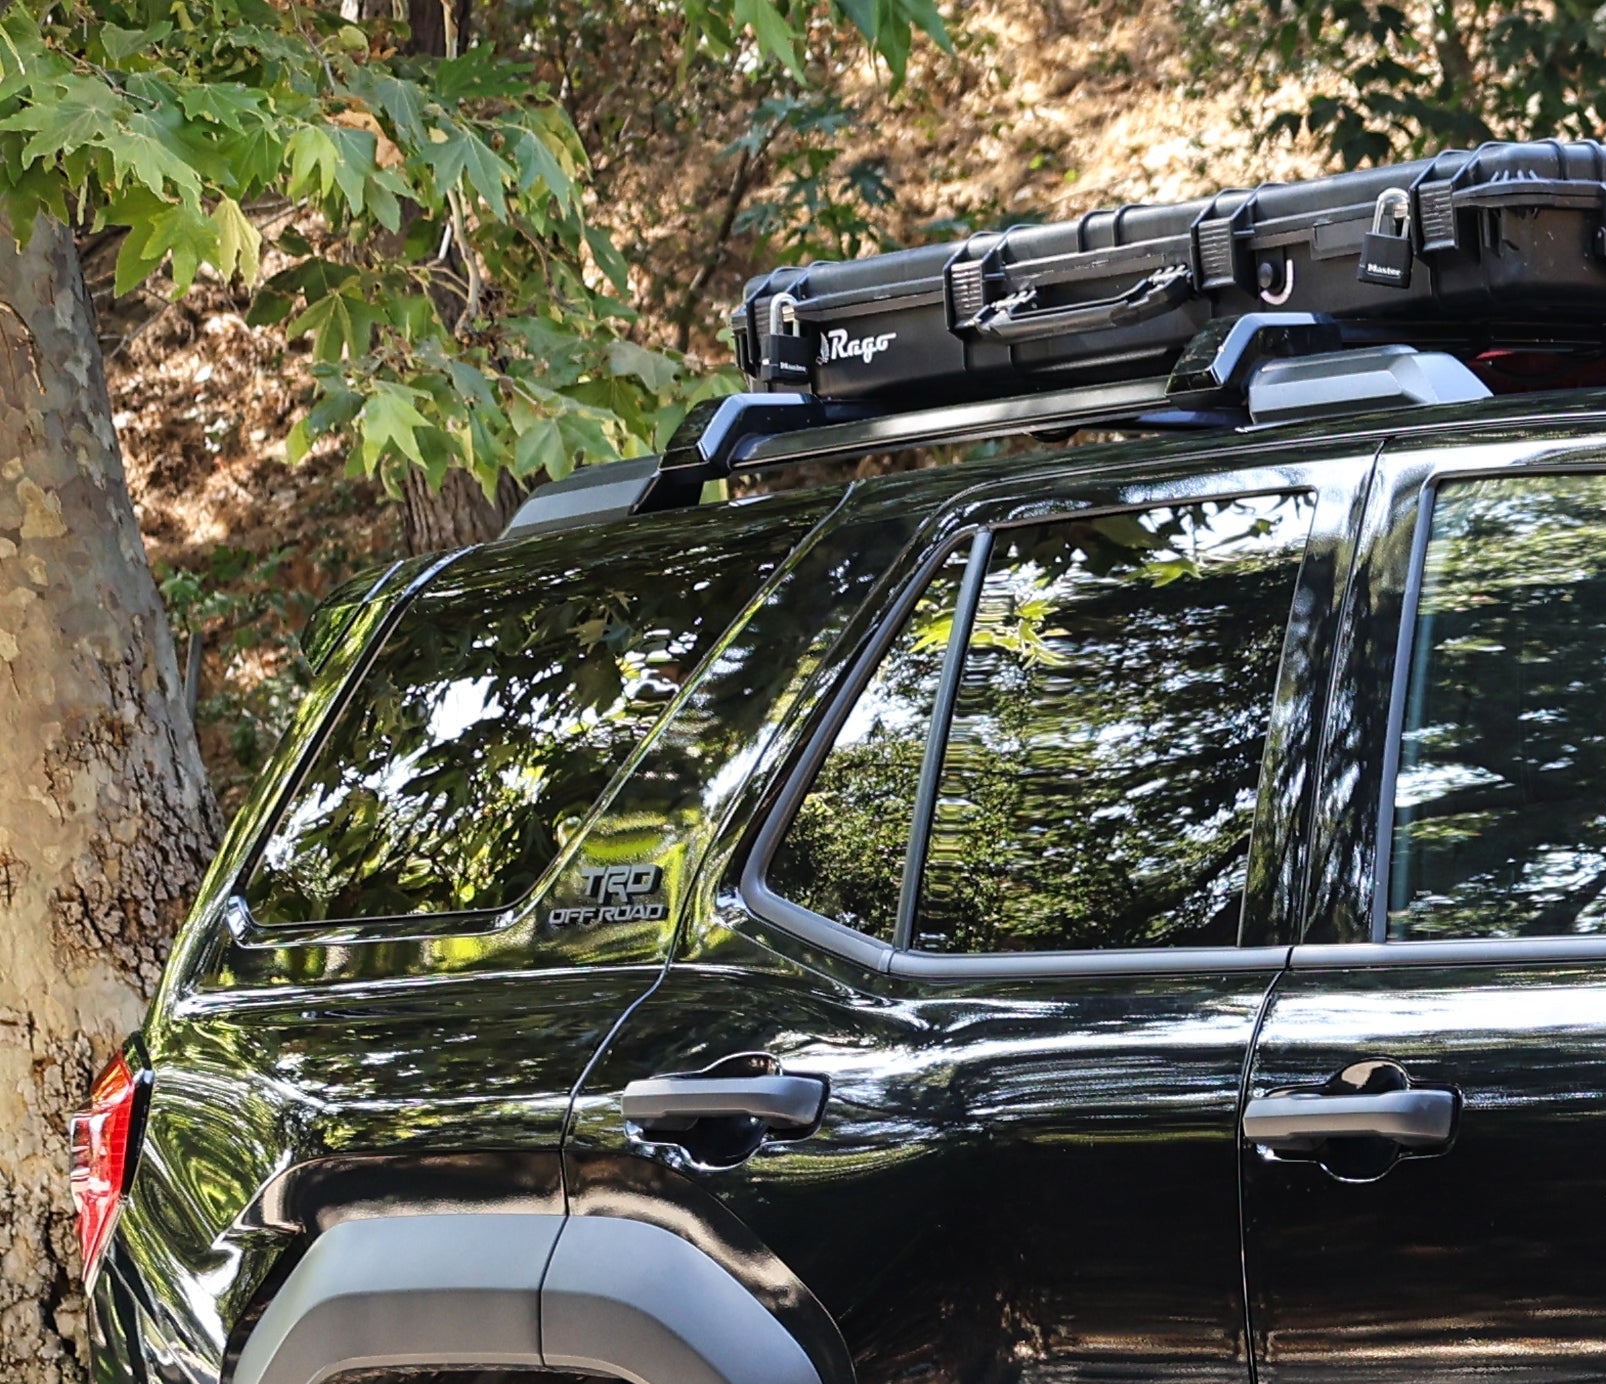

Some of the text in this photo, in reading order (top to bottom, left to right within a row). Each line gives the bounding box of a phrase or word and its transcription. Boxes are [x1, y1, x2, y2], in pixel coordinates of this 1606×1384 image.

[1367, 263, 1402, 276] Master
[828, 328, 897, 364] Rago
[581, 864, 662, 904] TRD
[549, 904, 668, 925] OFF ROAD
